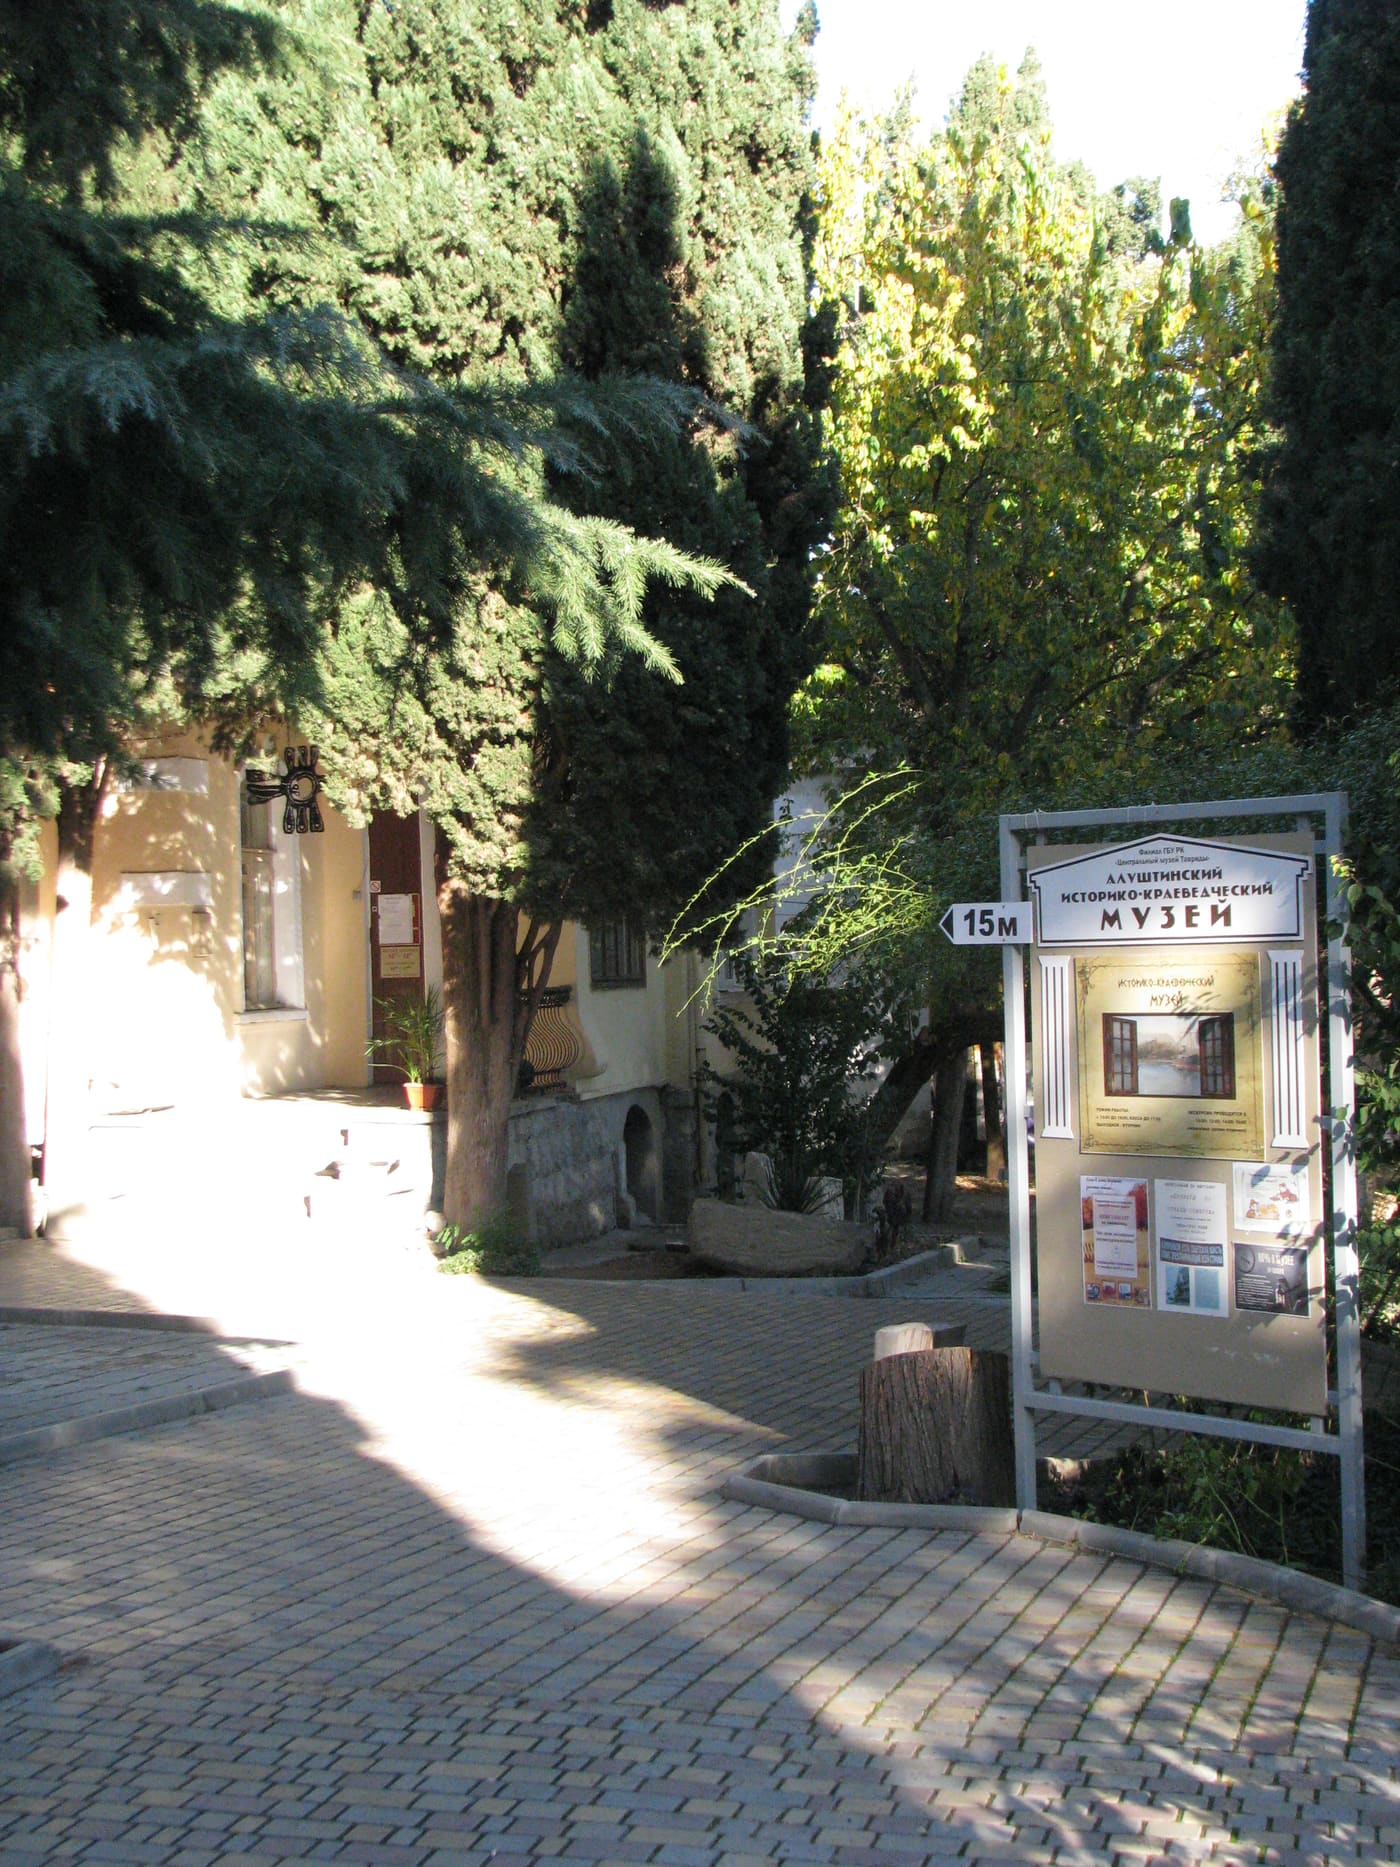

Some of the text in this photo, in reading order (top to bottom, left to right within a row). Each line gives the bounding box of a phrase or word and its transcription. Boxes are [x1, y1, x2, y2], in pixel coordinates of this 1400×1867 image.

[1106, 866, 1223, 885] АЛУШТИНСКИЙ
[1100, 899, 1232, 931] МУЗЕЙ
[1150, 990, 1183, 1008] МУЗЕЙ
